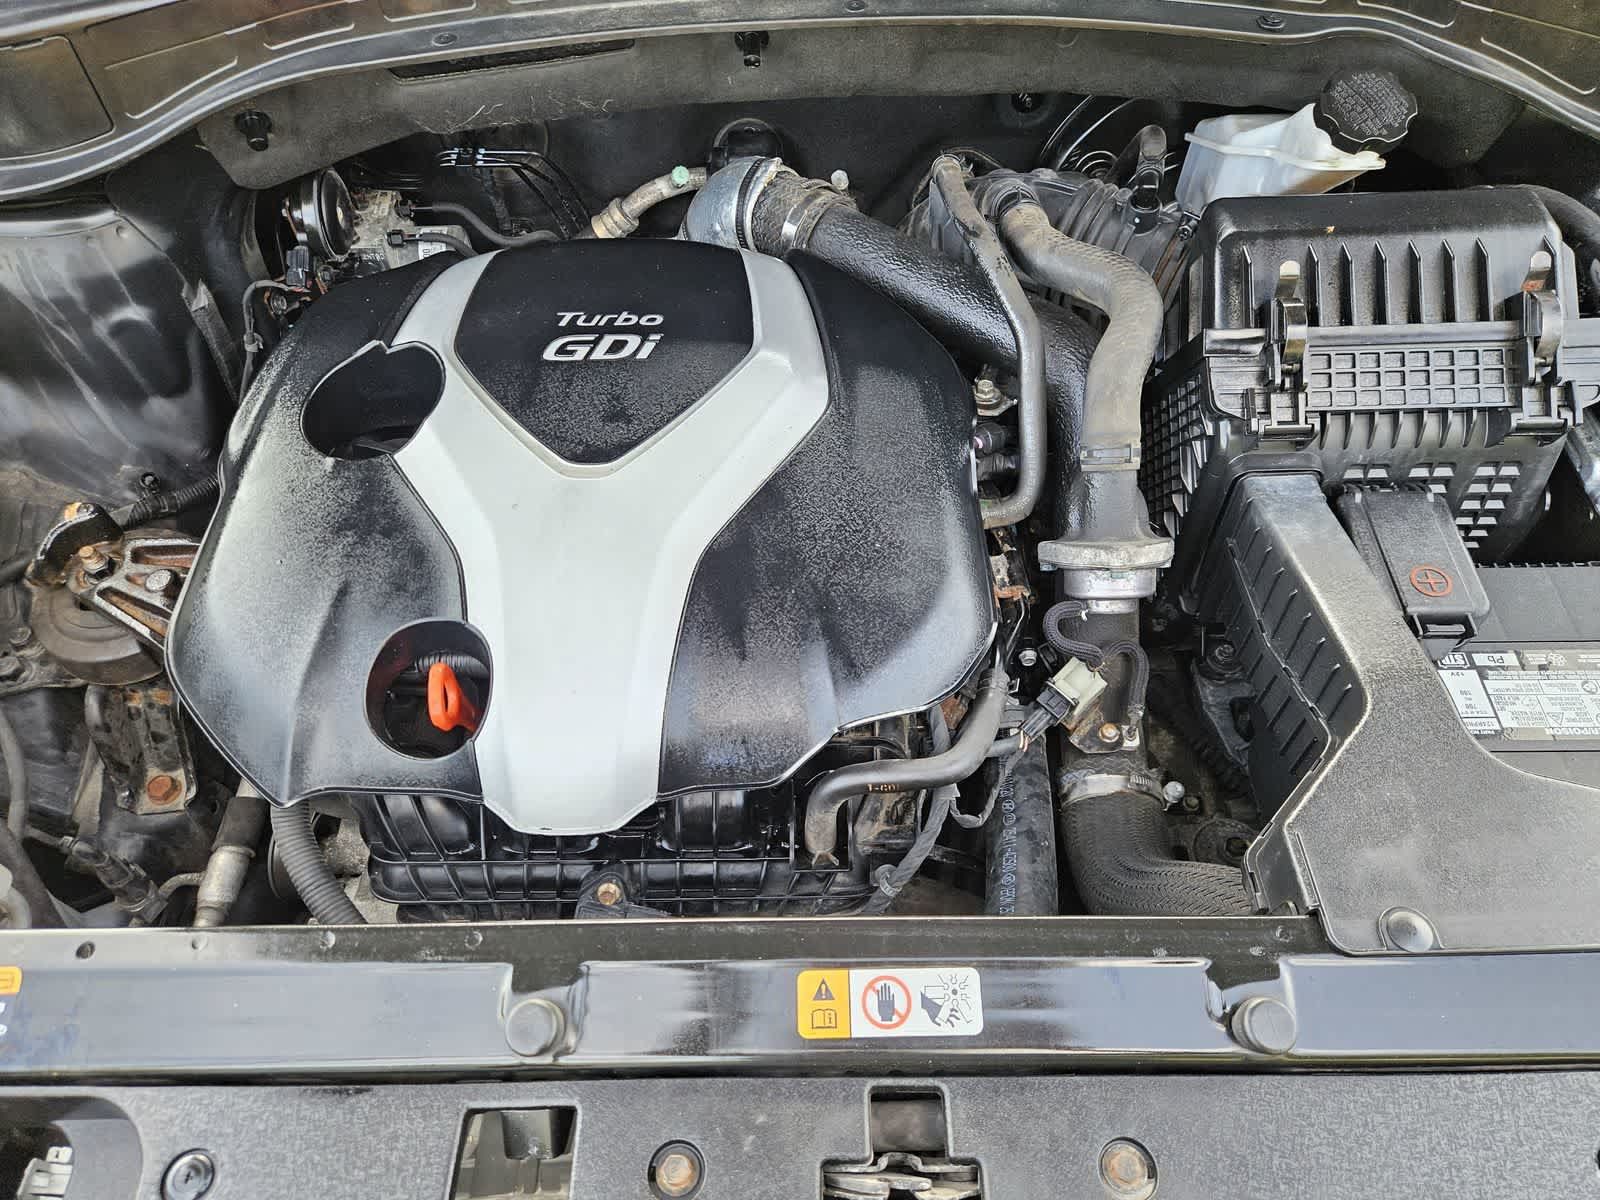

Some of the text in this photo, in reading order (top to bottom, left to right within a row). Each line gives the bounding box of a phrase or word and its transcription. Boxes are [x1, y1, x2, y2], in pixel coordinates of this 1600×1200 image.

[556, 311, 664, 327] Turbo
[542, 333, 664, 361] GDi
[1487, 655, 1505, 664] Pb
